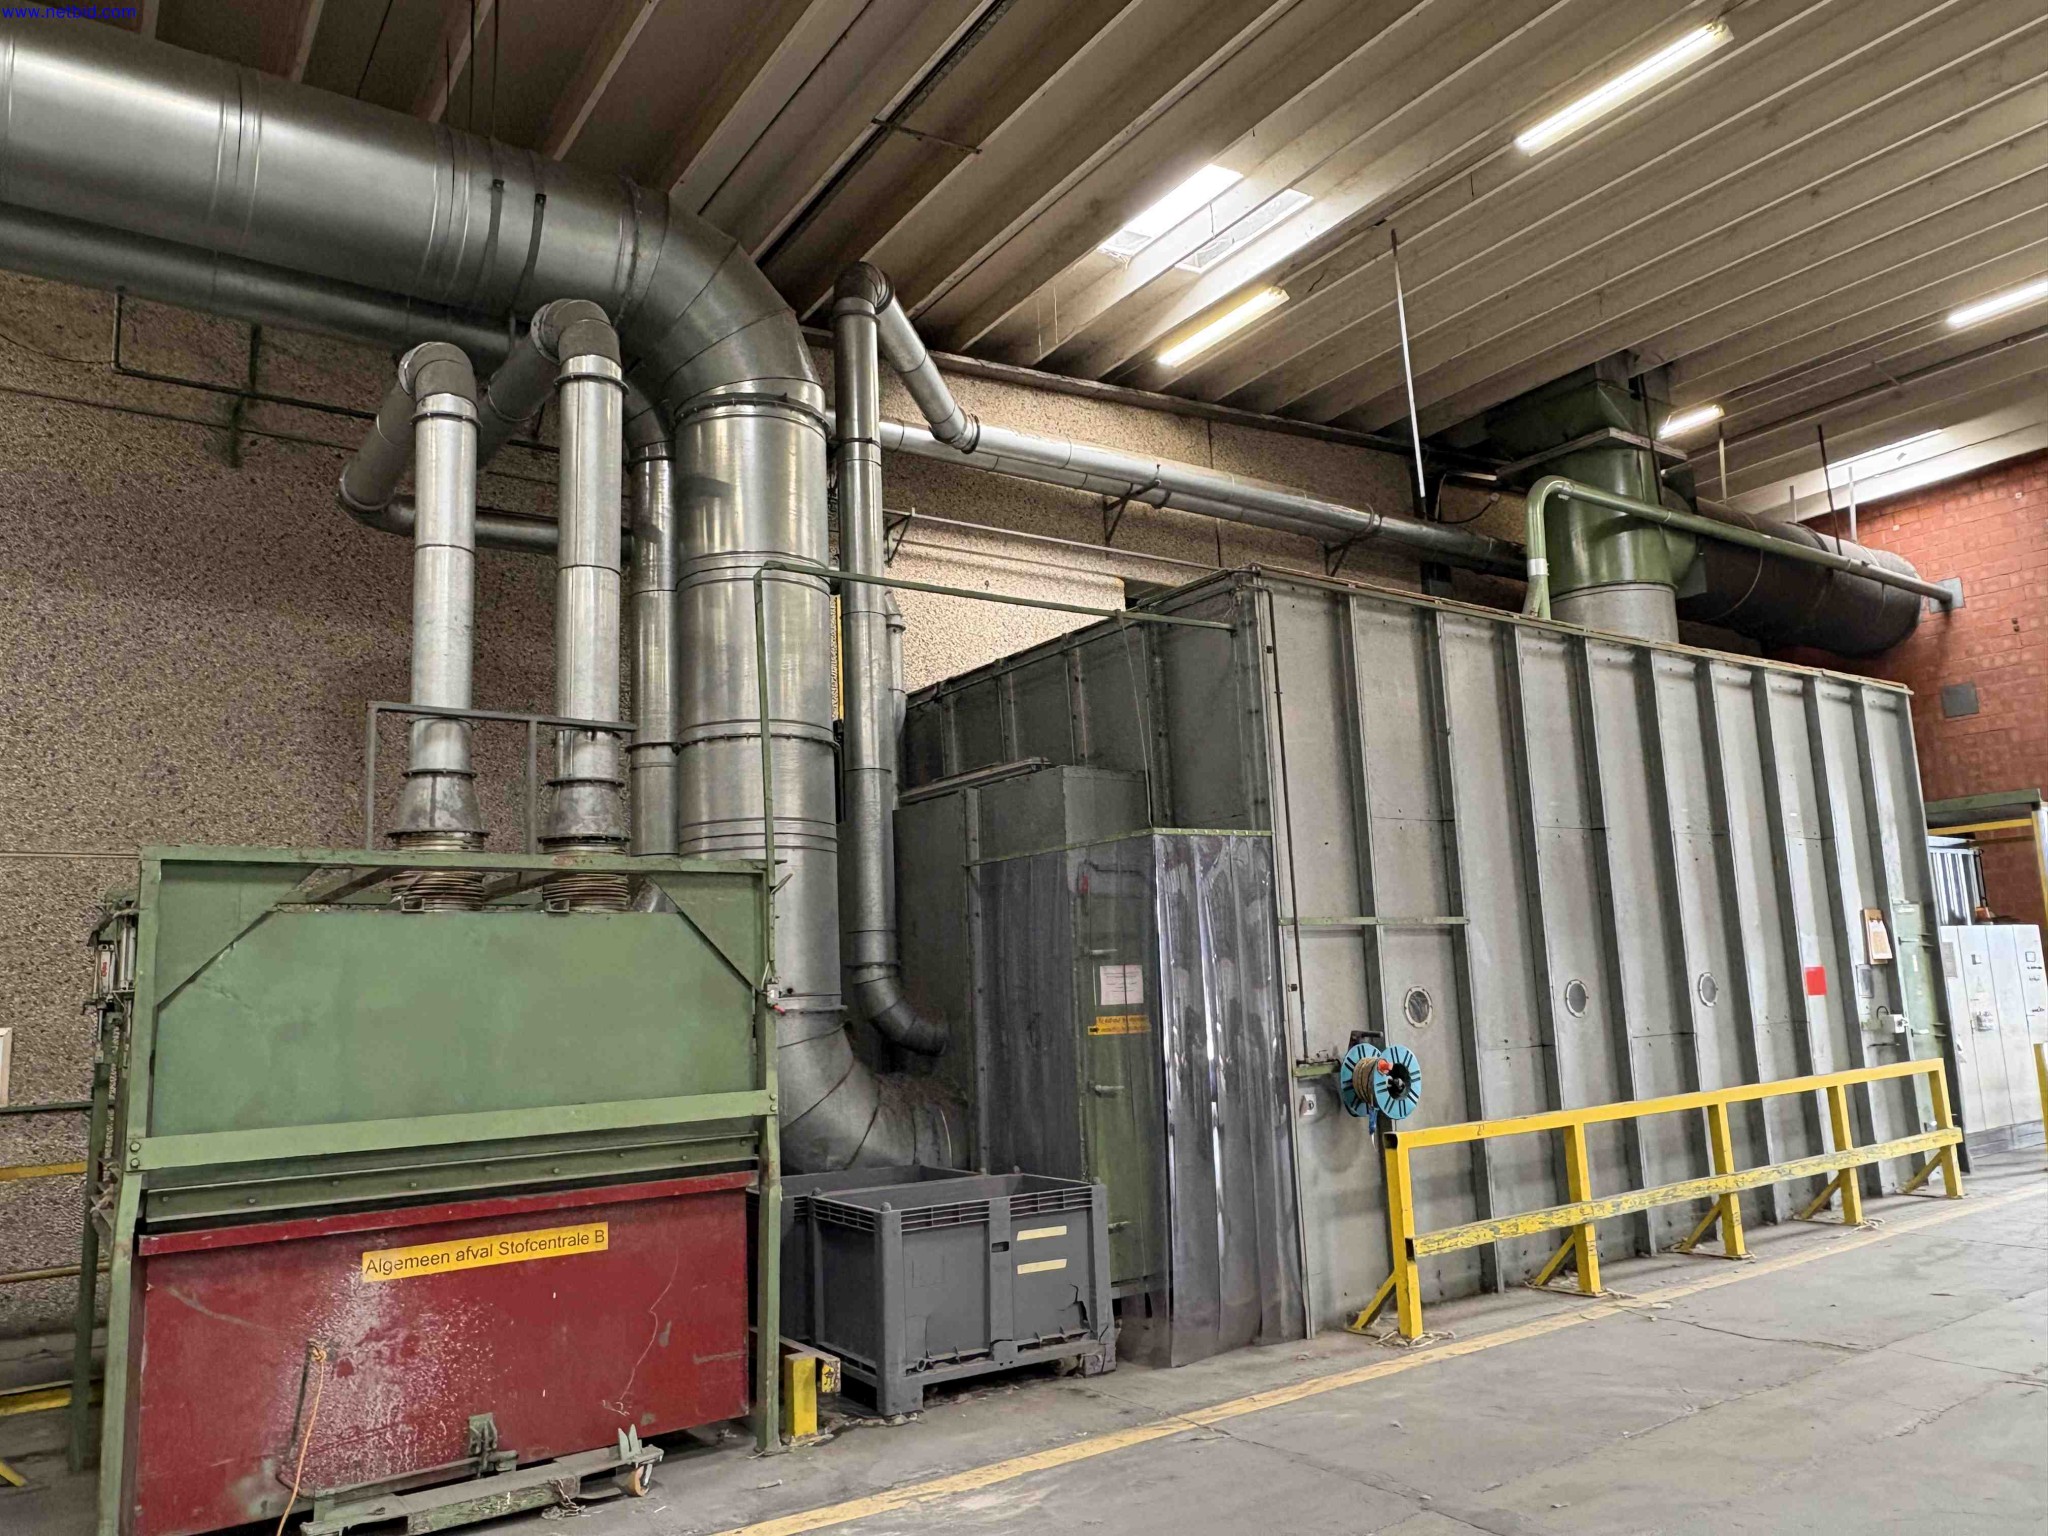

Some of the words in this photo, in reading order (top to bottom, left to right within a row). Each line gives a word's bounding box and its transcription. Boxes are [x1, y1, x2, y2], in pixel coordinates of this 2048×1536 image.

[365, 1252, 450, 1275] Algemeen
[456, 1244, 493, 1260] afval
[499, 1232, 589, 1256] Stofcentrale
[595, 1230, 605, 1243] B
